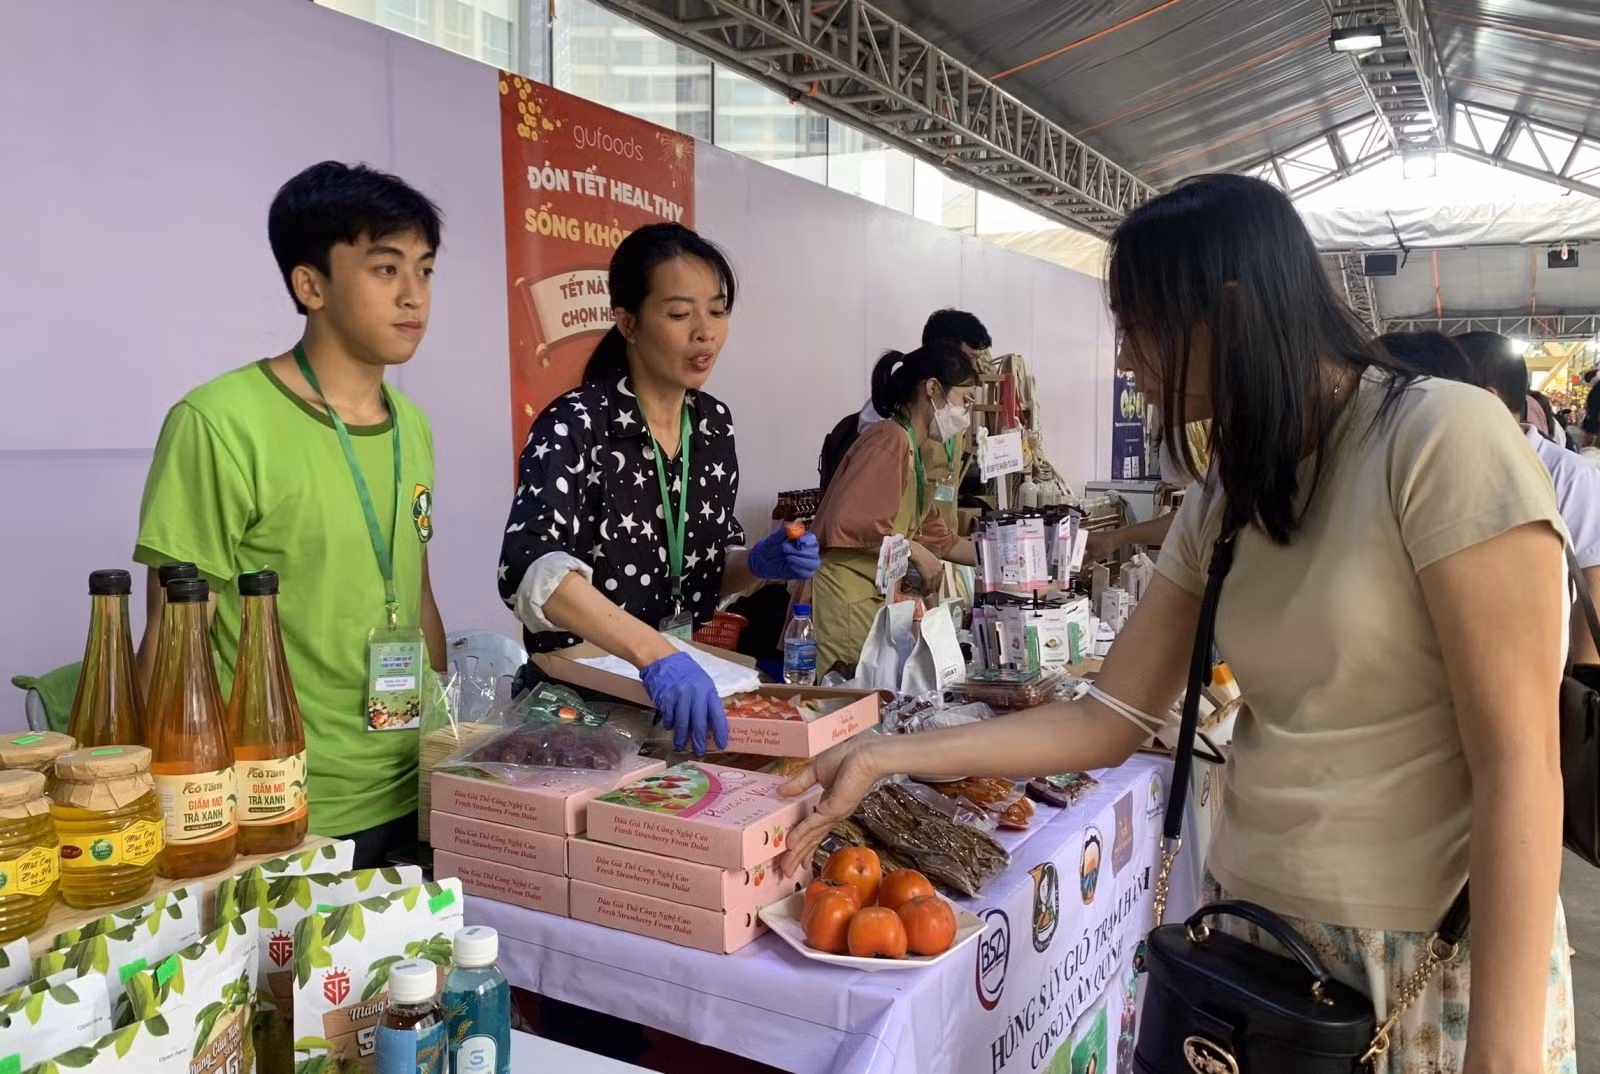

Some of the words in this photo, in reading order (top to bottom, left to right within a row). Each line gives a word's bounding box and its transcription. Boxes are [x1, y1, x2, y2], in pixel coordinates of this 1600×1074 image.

[573, 125, 643, 161] gufoods
[527, 160, 570, 192] ĐÓN
[572, 164, 607, 198] TẾT
[610, 178, 684, 222] HEALTHY
[524, 202, 580, 242] SỐNG
[584, 218, 633, 249] KHỎ
[560, 274, 584, 300] TẾT
[561, 306, 598, 328] CHỌN
[248, 794, 263, 805] TRÀ
[264, 794, 286, 805] XANH
[454, 799, 471, 808] Fresh
[504, 808, 520, 818] From
[183, 811, 200, 823] TRÀ
[201, 808, 223, 821] XANH
[614, 826, 633, 837] Fresh
[634, 829, 669, 844] Strawberry
[671, 837, 689, 847] From
[690, 840, 709, 852] Dalat
[694, 832, 709, 841] Cao
[596, 866, 615, 877] Fresh
[616, 871, 651, 886] Strawberry
[652, 878, 671, 889] From
[671, 882, 690, 893] Dalat
[675, 872, 689, 882] Cao
[597, 907, 616, 918] Fresh
[617, 911, 653, 928] Strawberry
[653, 919, 672, 930] From
[673, 923, 692, 936] Dalat
[677, 915, 691, 925] Cao
[268, 941, 294, 968] SG
[323, 977, 351, 1006] SG
[991, 996, 1036, 1074] HỒNG
[1064, 927, 1091, 982] GIÓ
